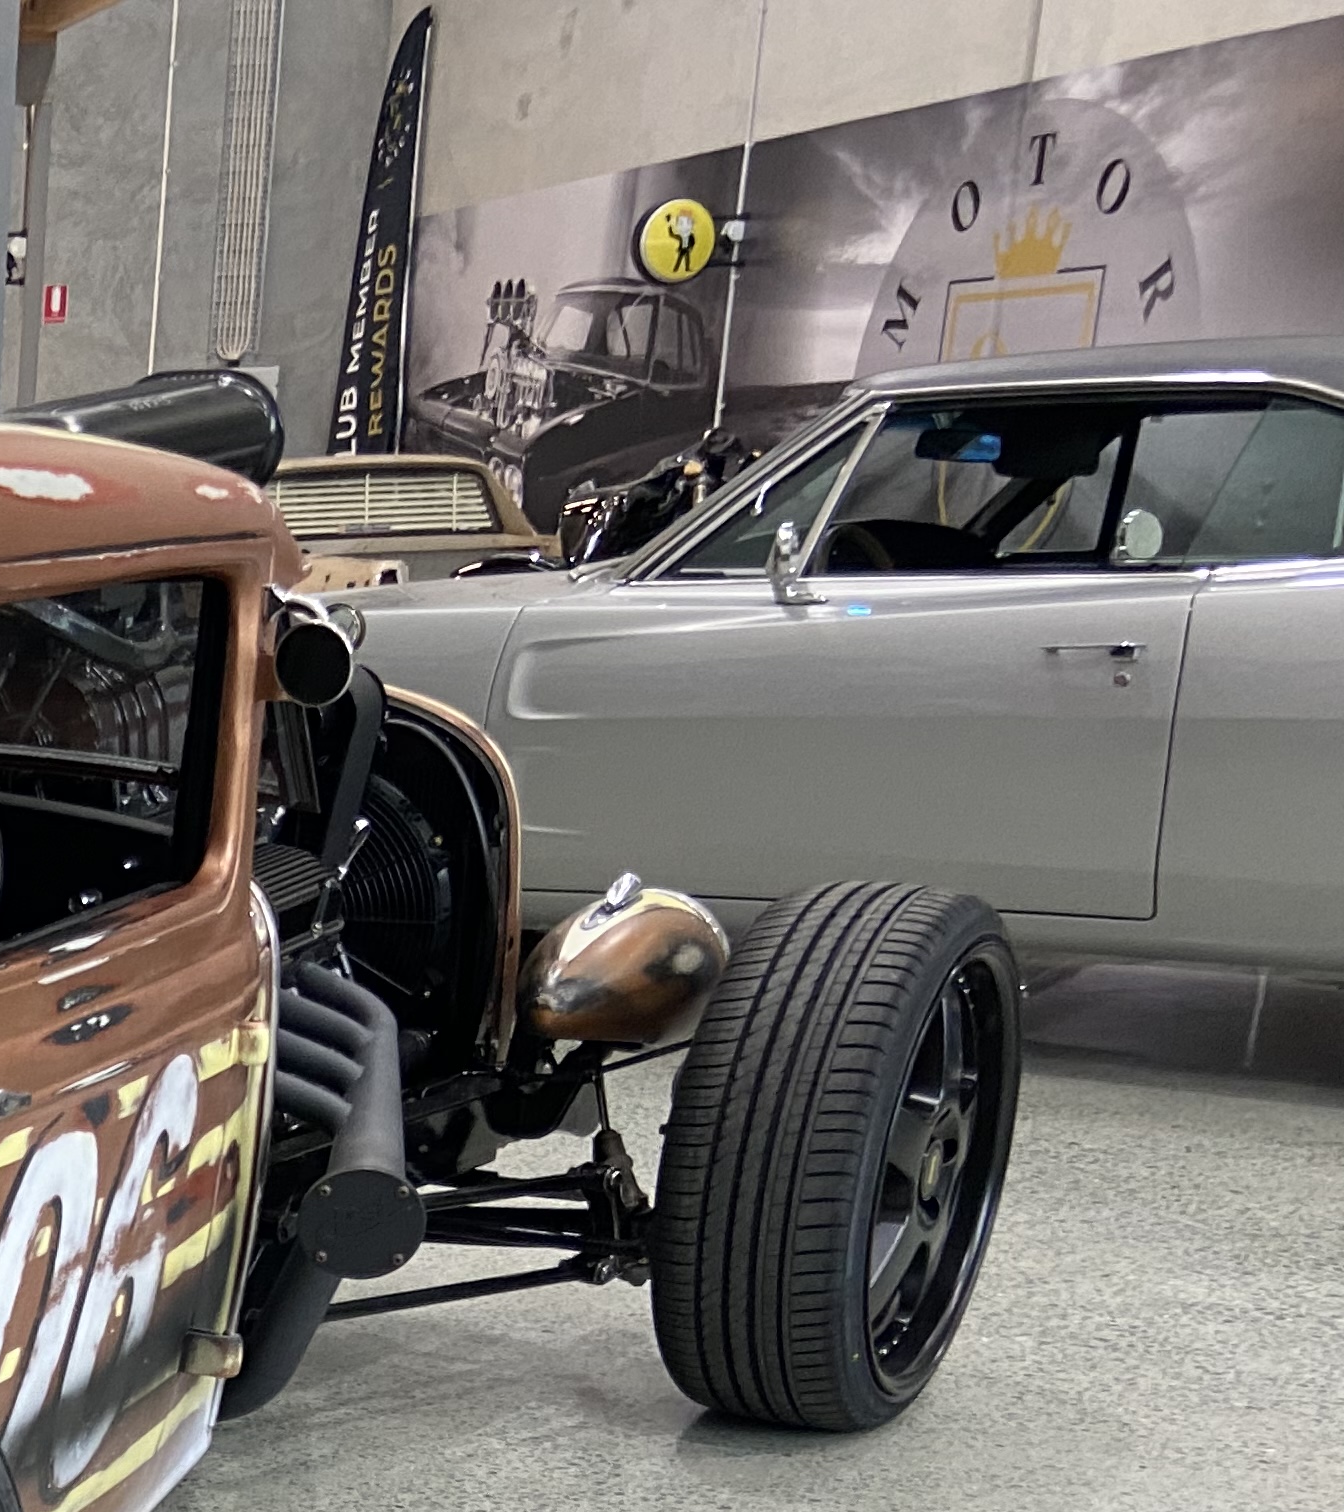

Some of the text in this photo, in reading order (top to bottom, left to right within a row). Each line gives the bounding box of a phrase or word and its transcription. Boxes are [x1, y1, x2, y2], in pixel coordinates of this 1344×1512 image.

[333, 208, 380, 457] LUB MEMBER
[368, 243, 398, 436] REWARDS
[881, 132, 1176, 352] MOTOR
